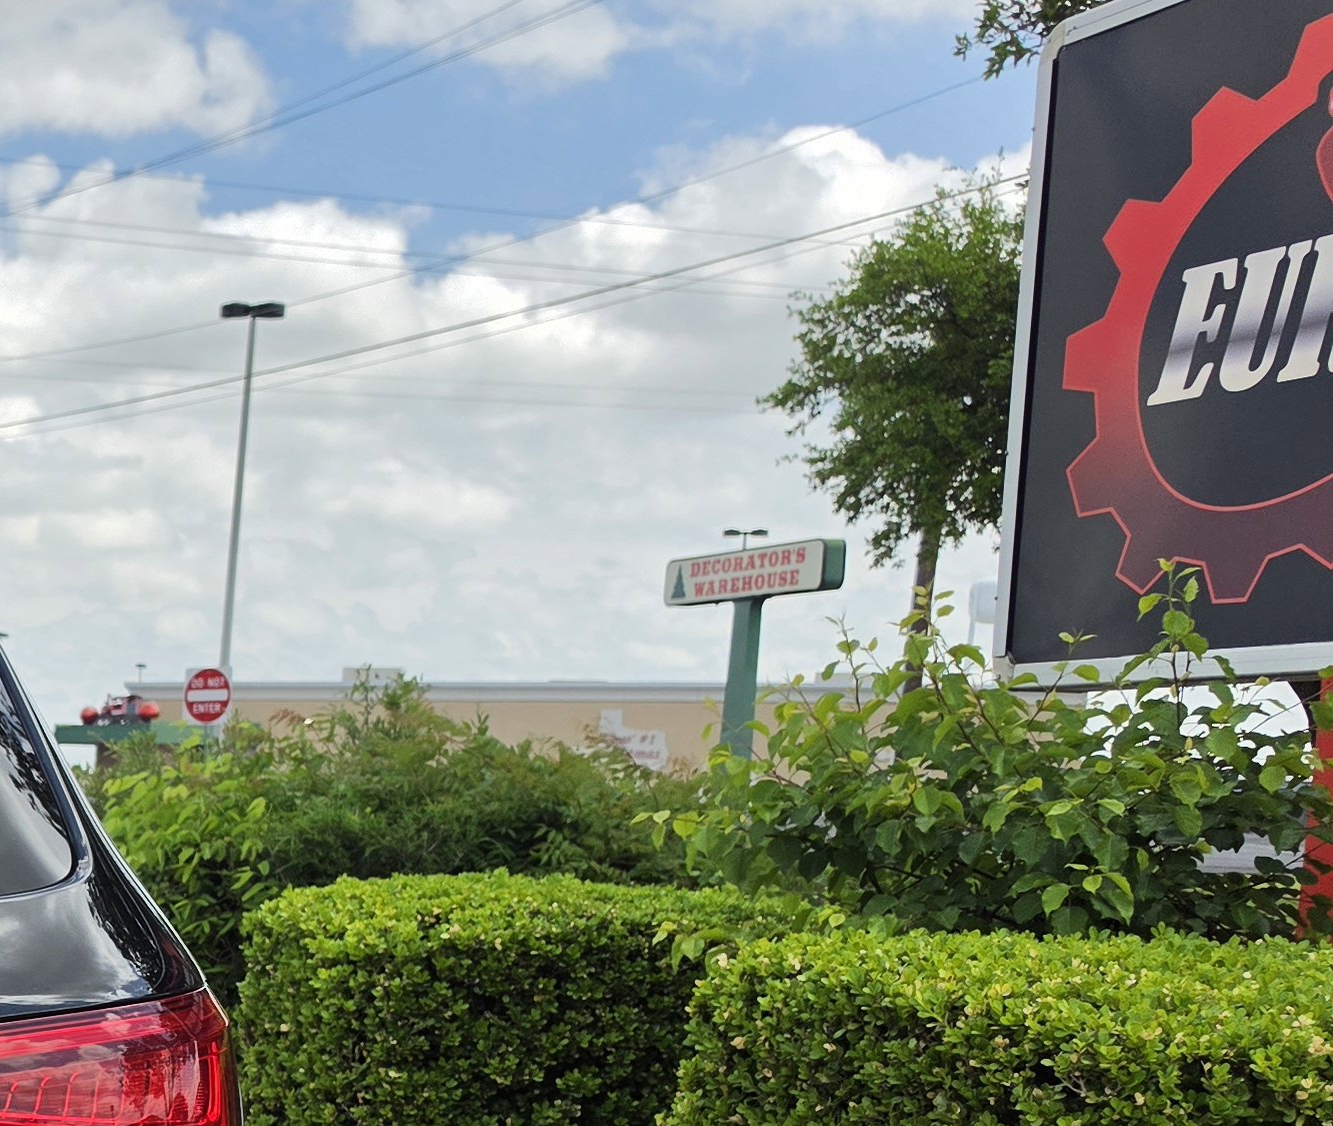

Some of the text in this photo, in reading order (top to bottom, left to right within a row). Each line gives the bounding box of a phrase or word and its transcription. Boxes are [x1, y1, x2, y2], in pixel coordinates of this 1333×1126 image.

[690, 547, 806, 578] DECORATOR'S
[694, 569, 800, 598] WAREHOUSE
[191, 676, 225, 688] DO NOT
[193, 702, 221, 714] ENTER
